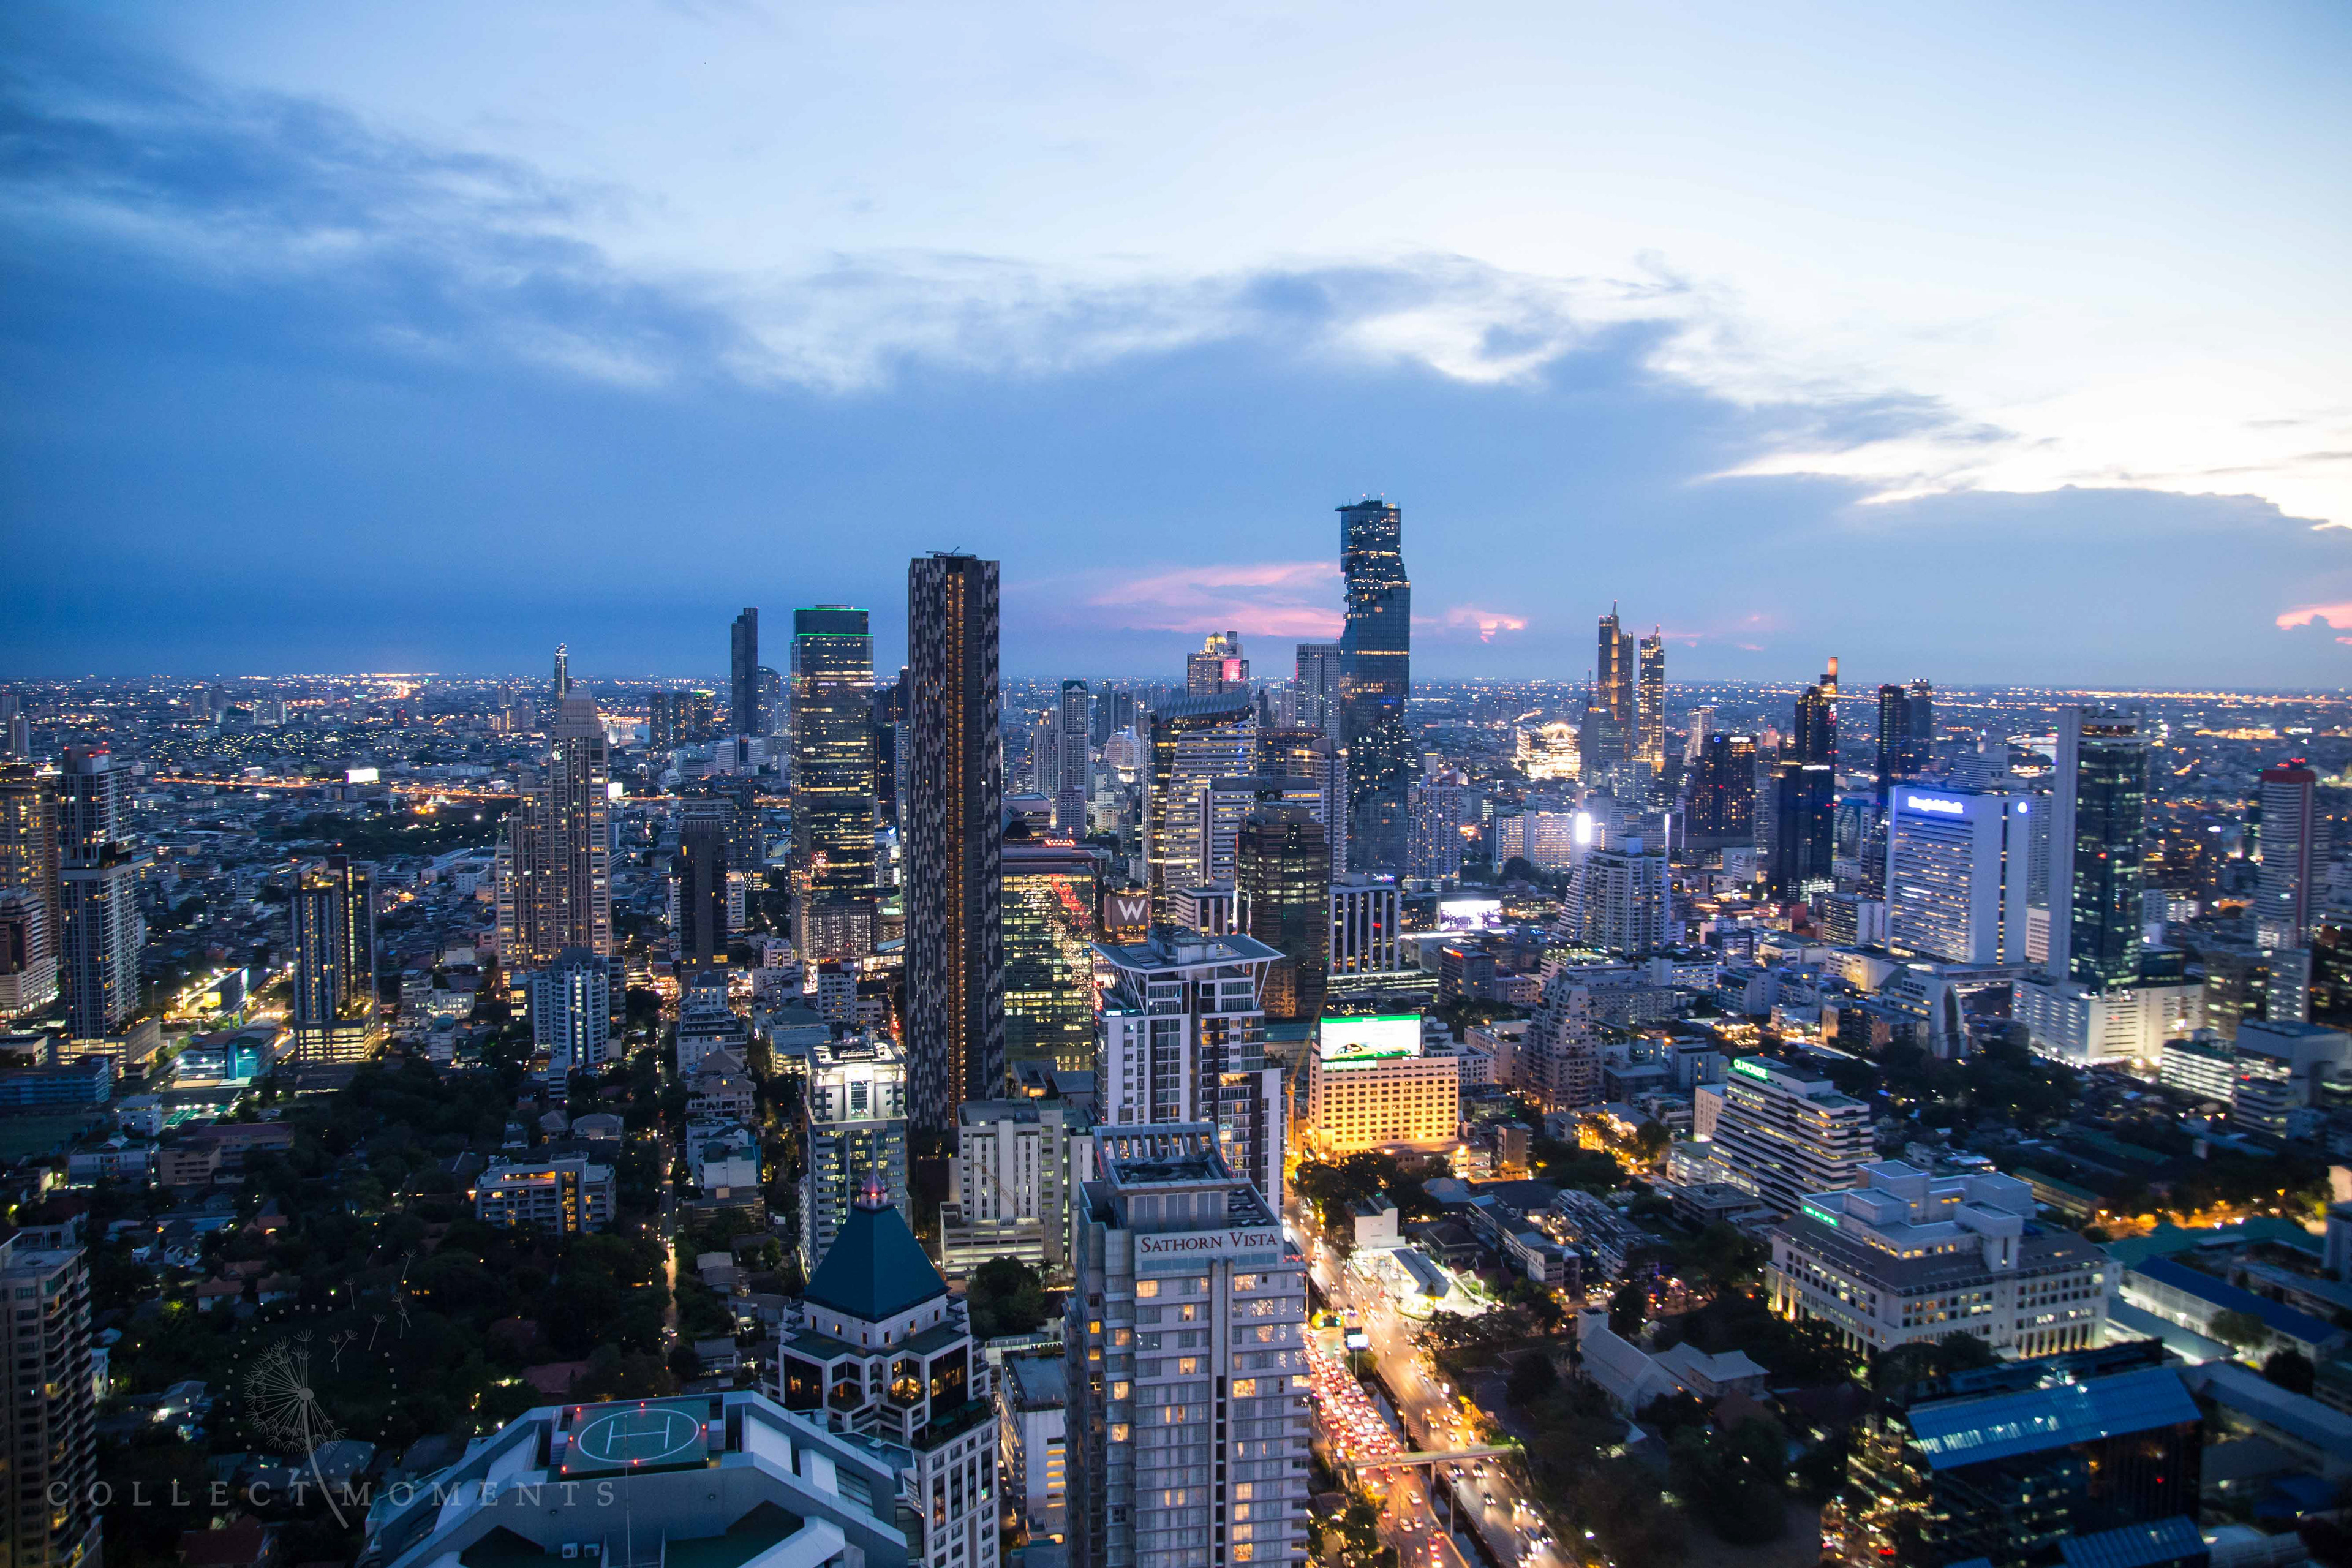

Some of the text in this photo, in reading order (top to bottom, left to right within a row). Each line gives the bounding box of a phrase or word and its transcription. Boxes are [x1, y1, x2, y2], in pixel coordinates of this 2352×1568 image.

[1117, 899, 1146, 921] W
[1141, 1231, 1277, 1253] SATHORN VISTA
[606, 1415, 671, 1454] H
